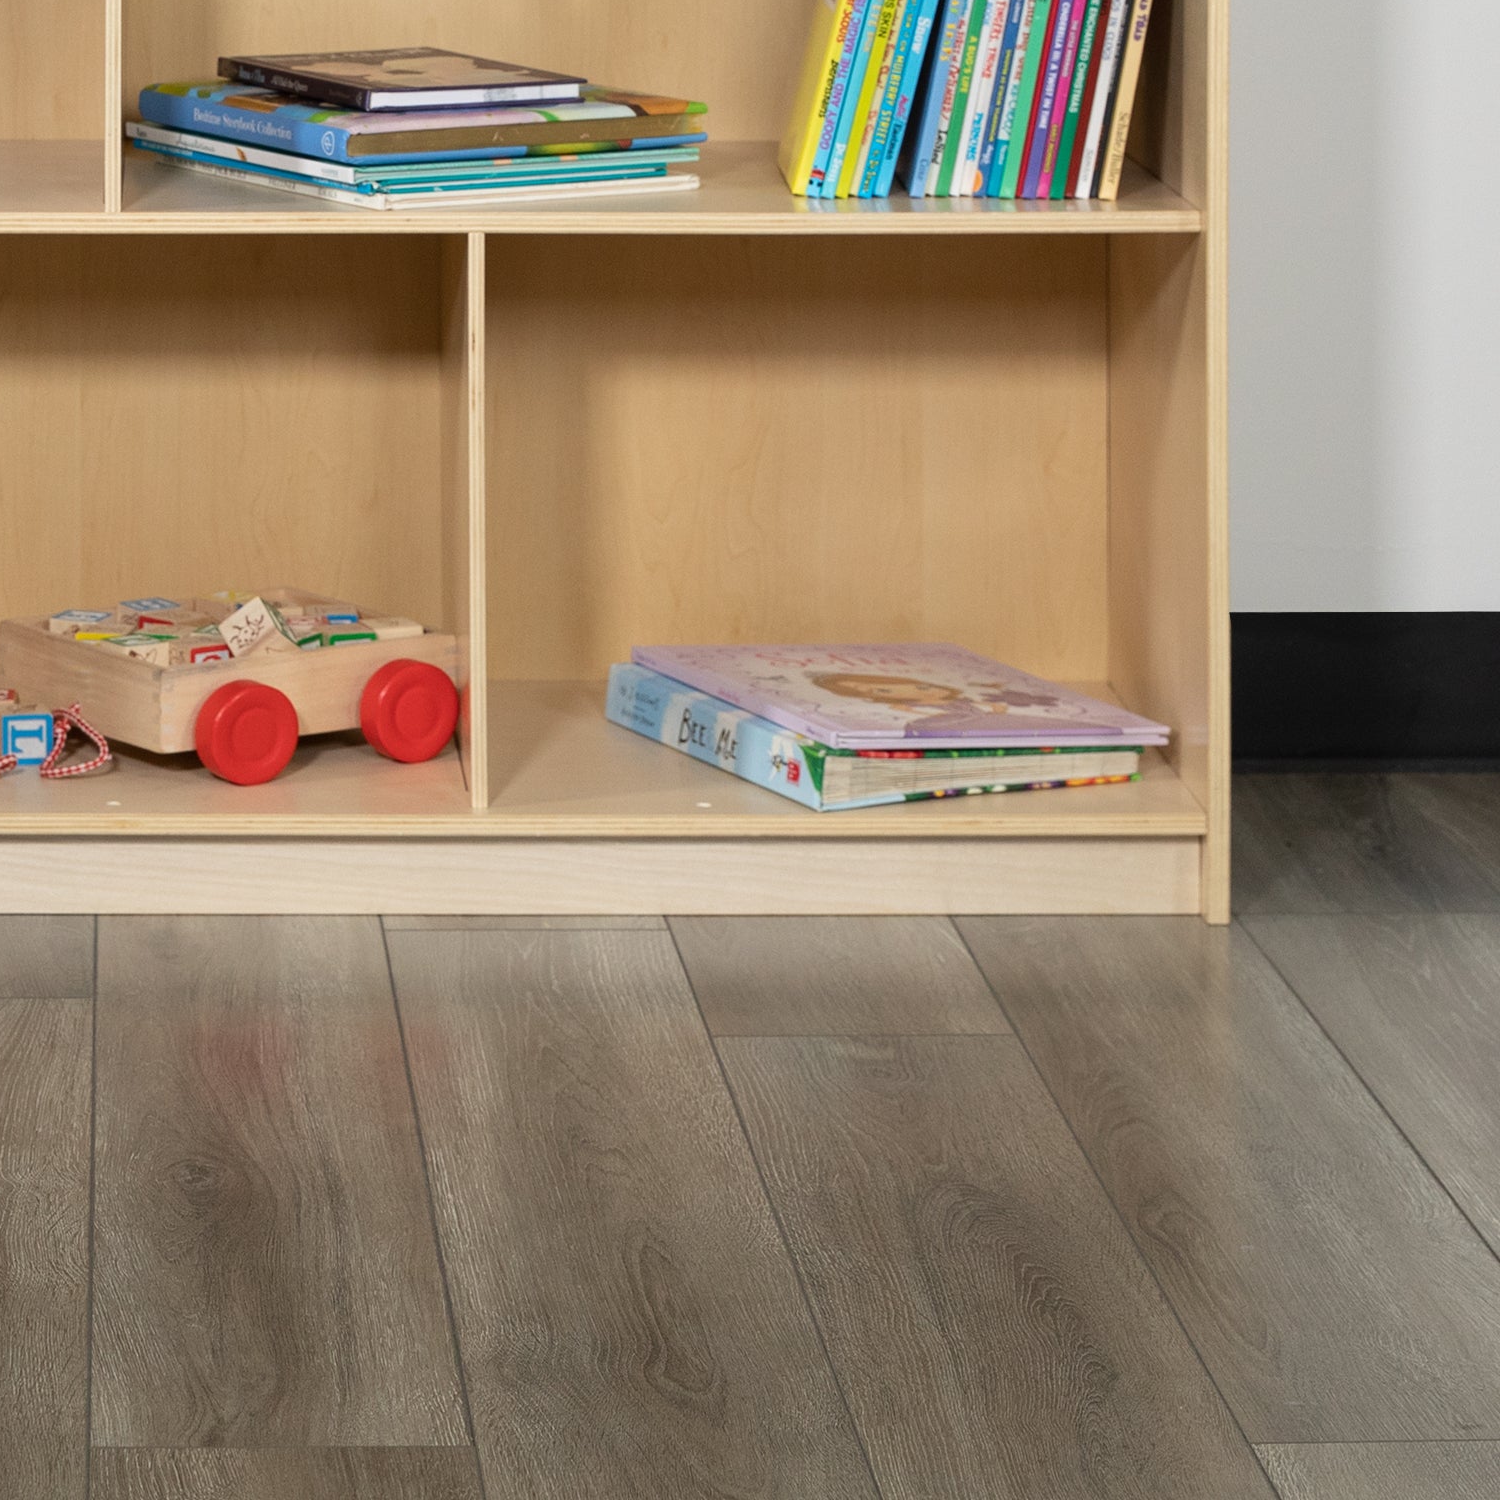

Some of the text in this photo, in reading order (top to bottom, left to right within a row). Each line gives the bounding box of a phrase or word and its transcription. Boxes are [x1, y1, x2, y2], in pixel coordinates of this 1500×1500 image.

[841, 16, 861, 54] MAGIC
[876, 10, 892, 39] SKIN
[908, 14, 932, 55] Snow
[987, 0, 1006, 44] FINGERS,
[1053, 0, 1070, 50] CINDERELLA
[1078, 6, 1098, 61] ENCHANTED
[1107, 15, 1118, 28] IN
[1132, 12, 1148, 42] TOAD
[1100, 30, 1115, 61] CLOGS
[835, 57, 851, 79] THE
[959, 35, 977, 93] A BUG'S LIFE
[980, 46, 996, 79] THUMB
[1049, 62, 1058, 71] A
[828, 81, 844, 107] AND
[882, 53, 907, 106] MULBERRY
[1044, 71, 1056, 96] TWIST
[1067, 60, 1087, 114] CHRISTMAS
[1038, 109, 1049, 129] TIME
[1042, 98, 1051, 109] IN
[193, 107, 292, 140] Bedtime Storybook Collection
[816, 110, 837, 151] GOOFY
[872, 108, 892, 144] STREET
[965, 111, 983, 161] PERKINS
